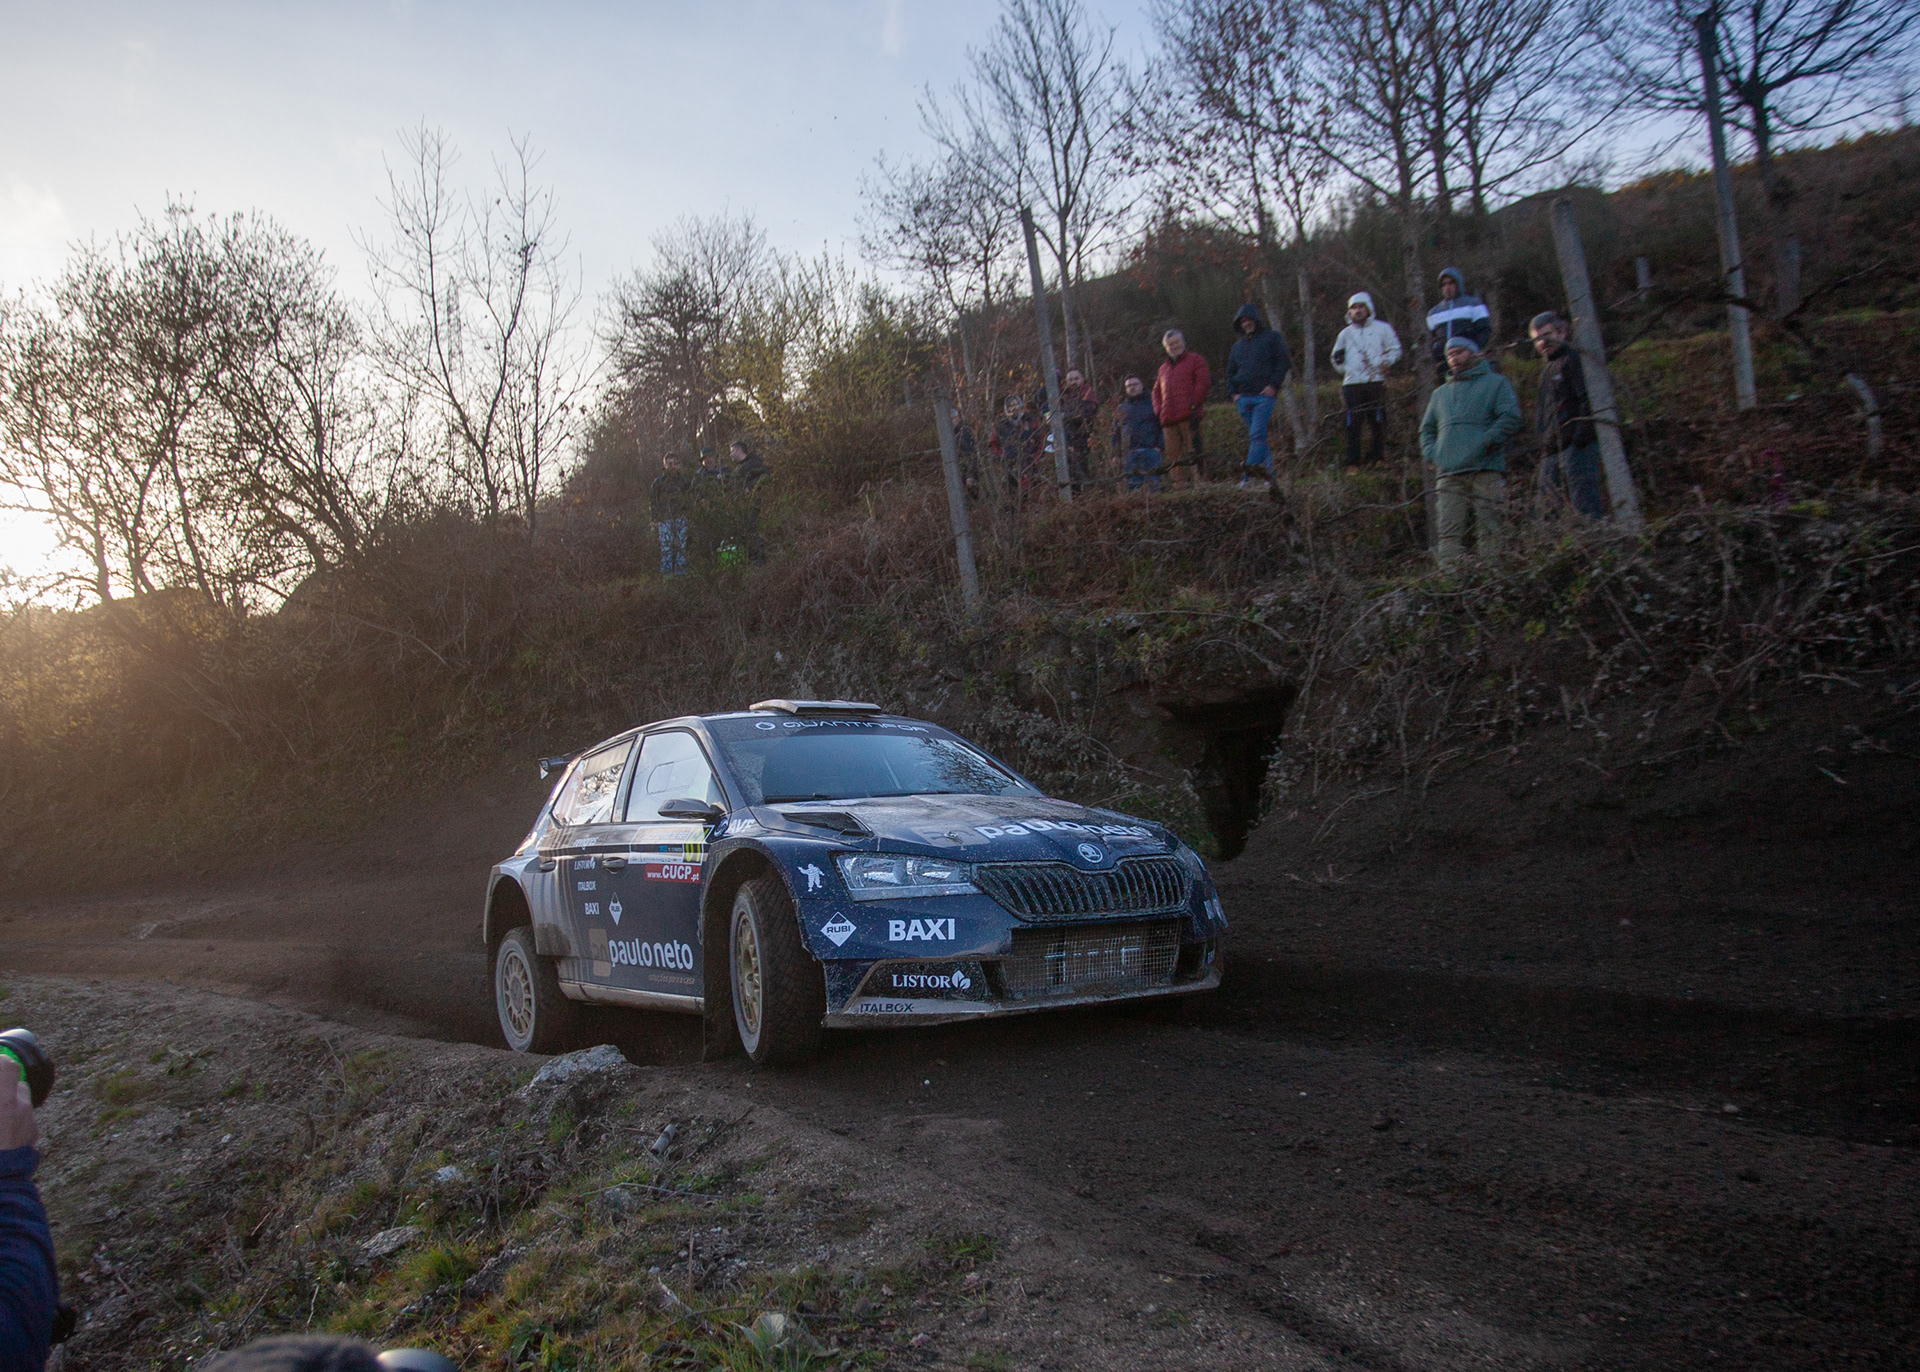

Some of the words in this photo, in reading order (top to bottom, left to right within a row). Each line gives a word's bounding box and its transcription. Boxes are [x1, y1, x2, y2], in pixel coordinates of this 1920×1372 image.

[783, 721, 929, 733] QUANTINFOR
[647, 865, 699, 882] www.CUCP.pt
[584, 902, 600, 915] BAXI
[826, 925, 851, 934] RUBI
[888, 918, 956, 941] BAXI
[892, 974, 952, 988] LISTOR
[860, 1003, 913, 1013] ITALBOX
